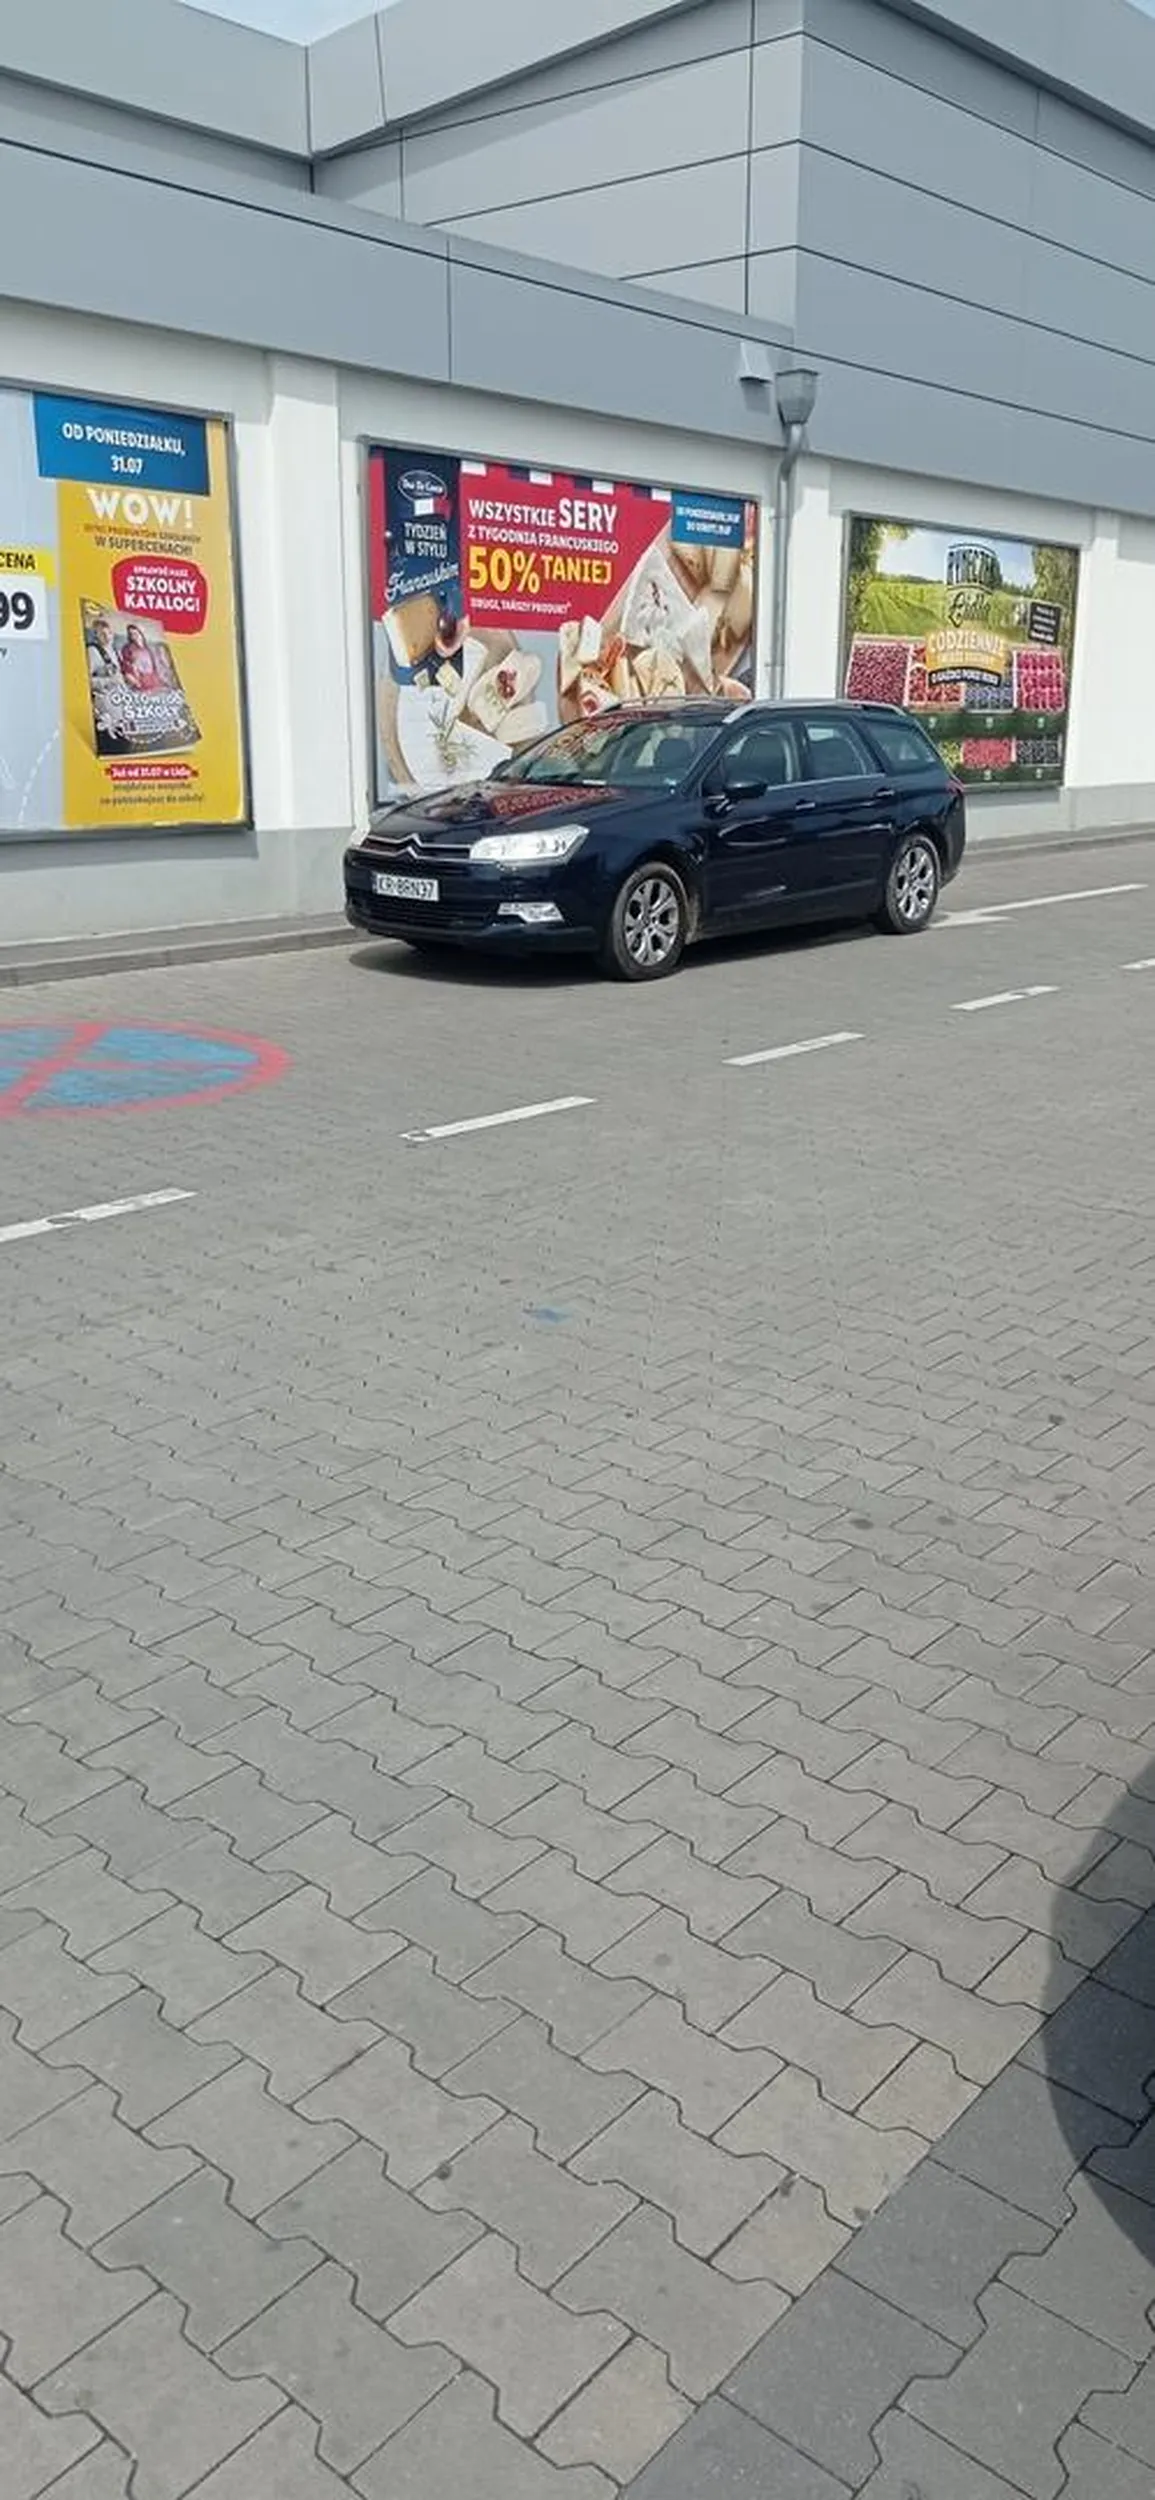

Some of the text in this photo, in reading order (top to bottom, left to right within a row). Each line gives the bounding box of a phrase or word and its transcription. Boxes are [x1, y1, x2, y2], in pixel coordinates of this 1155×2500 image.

[62, 422, 186, 456] OD PONIEDZIAŁKU,
[110, 455, 143, 475] 31.07
[86, 488, 194, 529] WOW!
[468, 498, 617, 534] WSZYSTKIE SERY
[403, 522, 447, 541] TYDZIEŃ
[467, 525, 619, 554] Z TYGODNIA FRANCUSKIEGO
[94, 536, 193, 556] W SUPERCENACH!
[404, 540, 447, 558] W STYLU
[468, 546, 612, 593] 50% TANIEJ
[126, 575, 197, 595] SZKOLNY
[124, 592, 200, 612] KATALOG!
